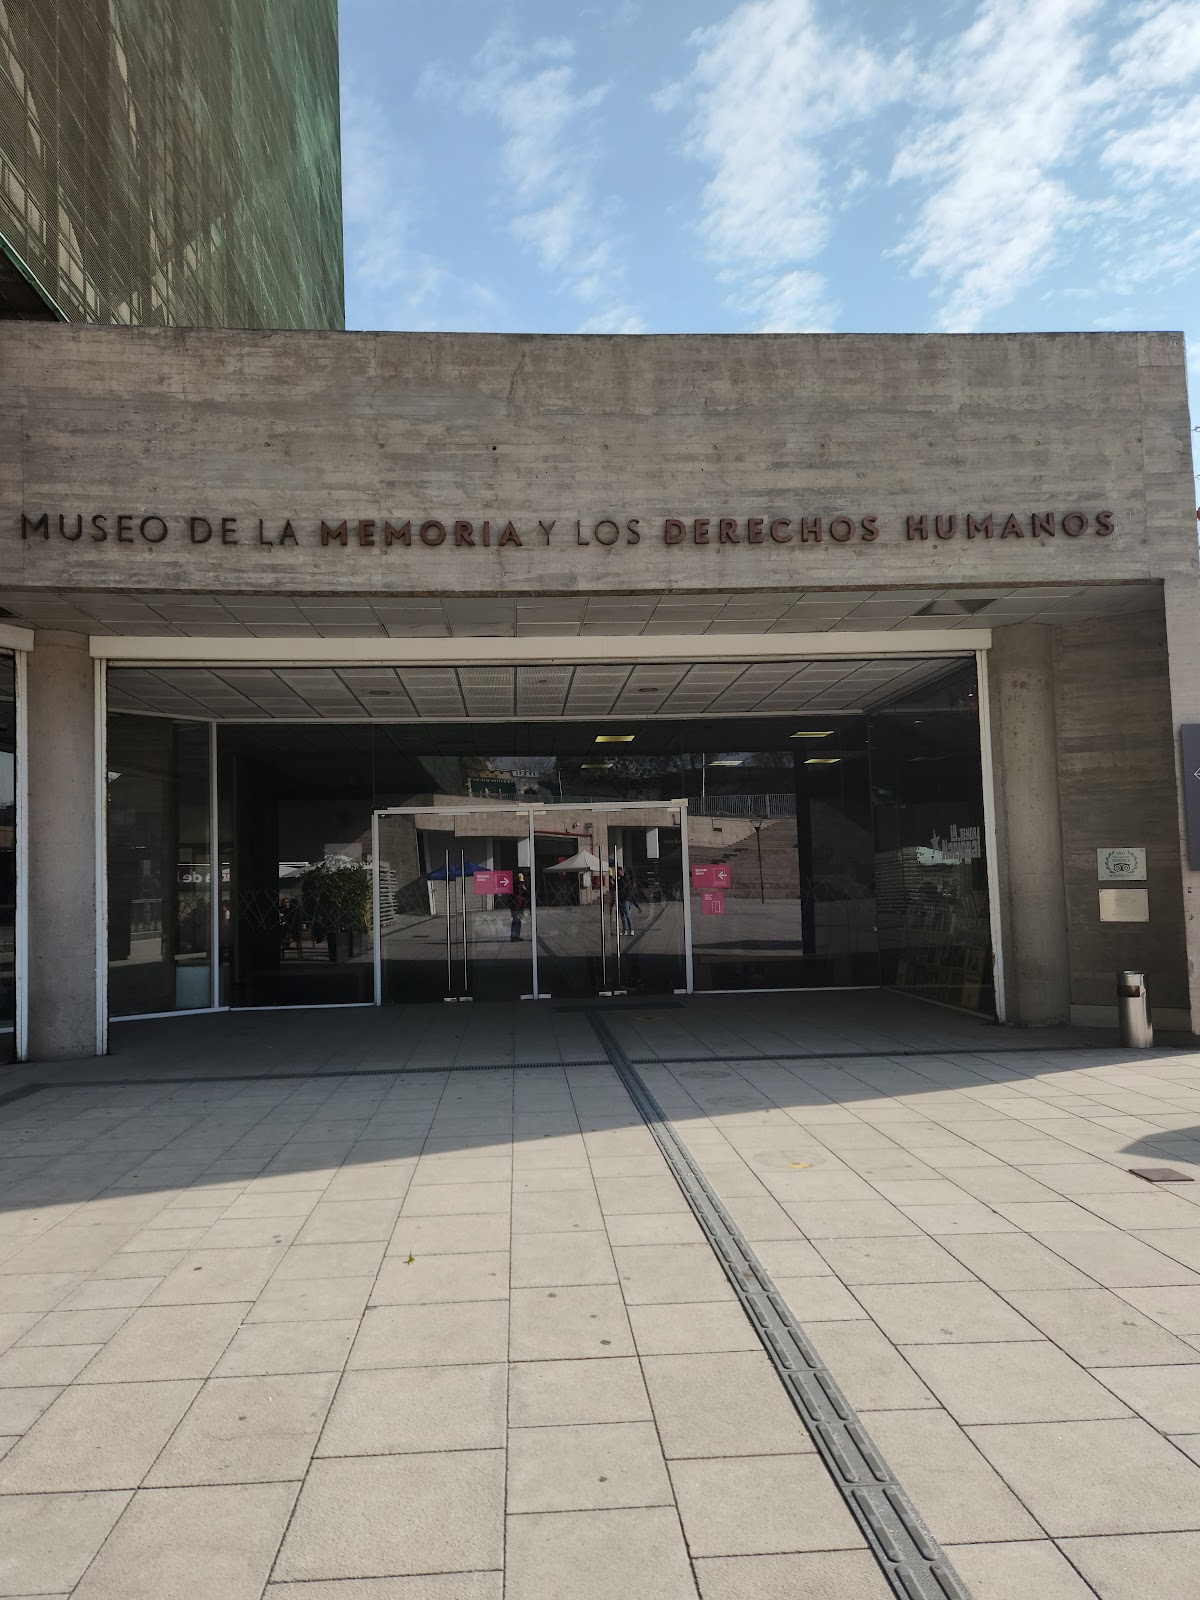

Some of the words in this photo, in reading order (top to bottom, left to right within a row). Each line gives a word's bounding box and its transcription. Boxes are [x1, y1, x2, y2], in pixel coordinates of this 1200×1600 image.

[22, 513, 166, 543] MUSEO
[189, 517, 239, 545] DE
[258, 519, 299, 547] LA
[320, 519, 523, 547] MEMORIA
[538, 519, 557, 547] Y
[577, 519, 641, 547] LOS
[664, 515, 879, 546] DERECHOS
[907, 510, 1116, 541] HUMANOS
